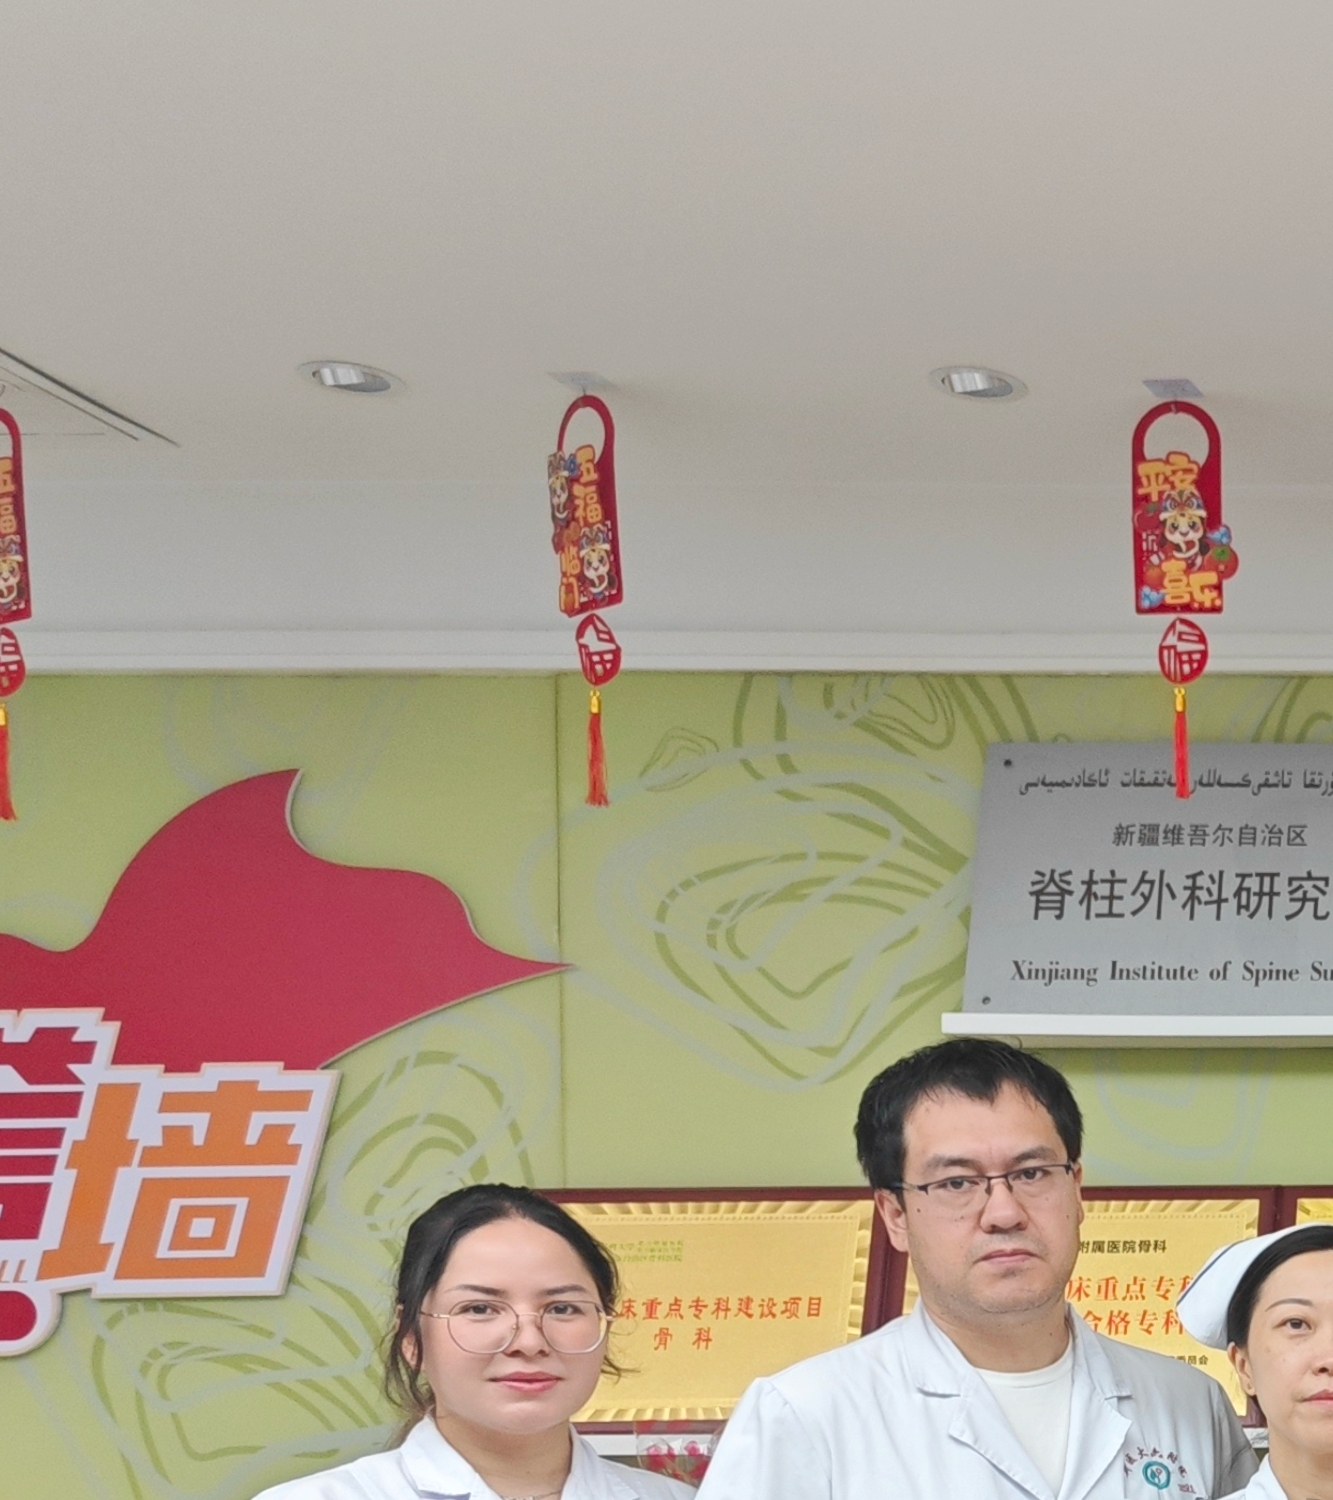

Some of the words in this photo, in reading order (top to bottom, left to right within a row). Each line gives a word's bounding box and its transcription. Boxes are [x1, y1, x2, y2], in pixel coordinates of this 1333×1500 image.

[1112, 823, 1309, 848] 新疆维吾尔自治区
[1010, 960, 1099, 988] Xinjiang
[1109, 960, 1199, 982] Institute
[1209, 961, 1232, 982] of
[1242, 961, 1300, 988] Spine
